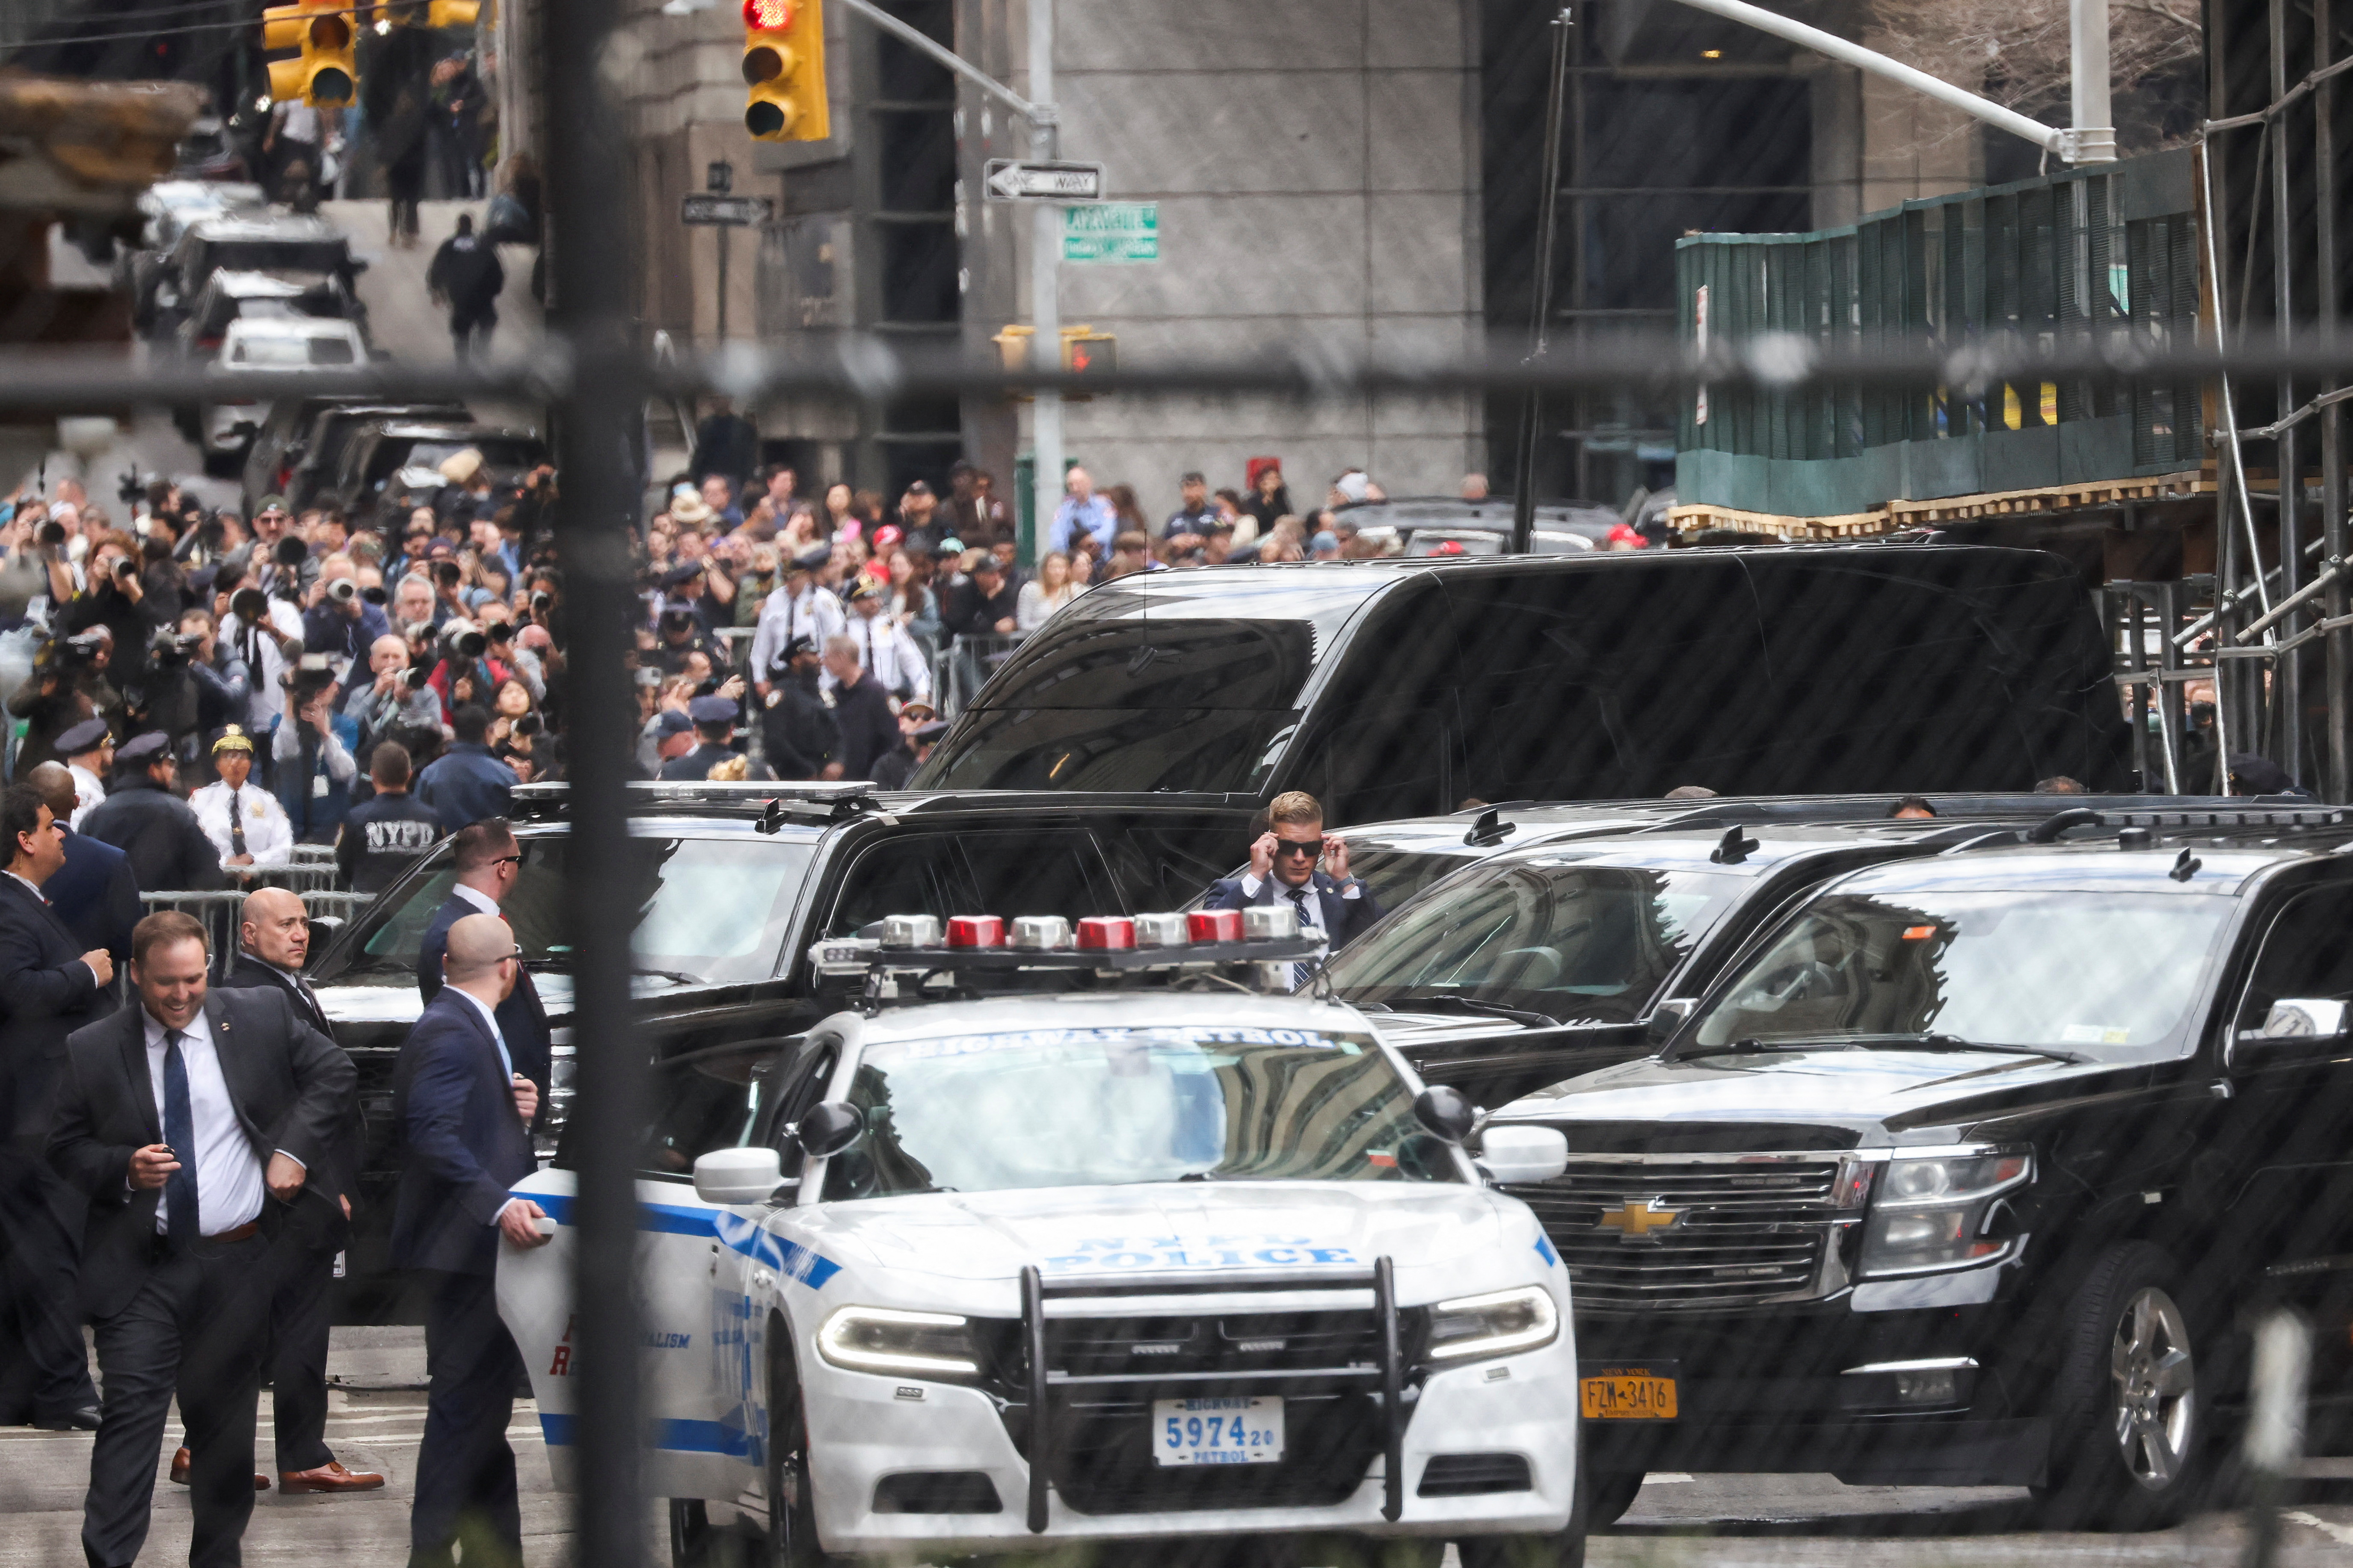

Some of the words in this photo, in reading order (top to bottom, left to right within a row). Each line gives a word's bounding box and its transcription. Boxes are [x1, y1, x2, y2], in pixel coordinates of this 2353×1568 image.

[1054, 172, 1092, 189] WAY
[365, 820, 434, 849] NYPD
[905, 1027, 1132, 1059] HIGHWAY
[1150, 1027, 1335, 1048] PATROL
[1075, 1234, 1312, 1252] NYPD
[1043, 1248, 1357, 1272] POLICE
[1627, 1381, 1666, 1408] 3416
[1166, 1416, 1246, 1448] 5974
[1251, 1430, 1274, 1447] 20
[1193, 1450, 1249, 1464] PATROL
